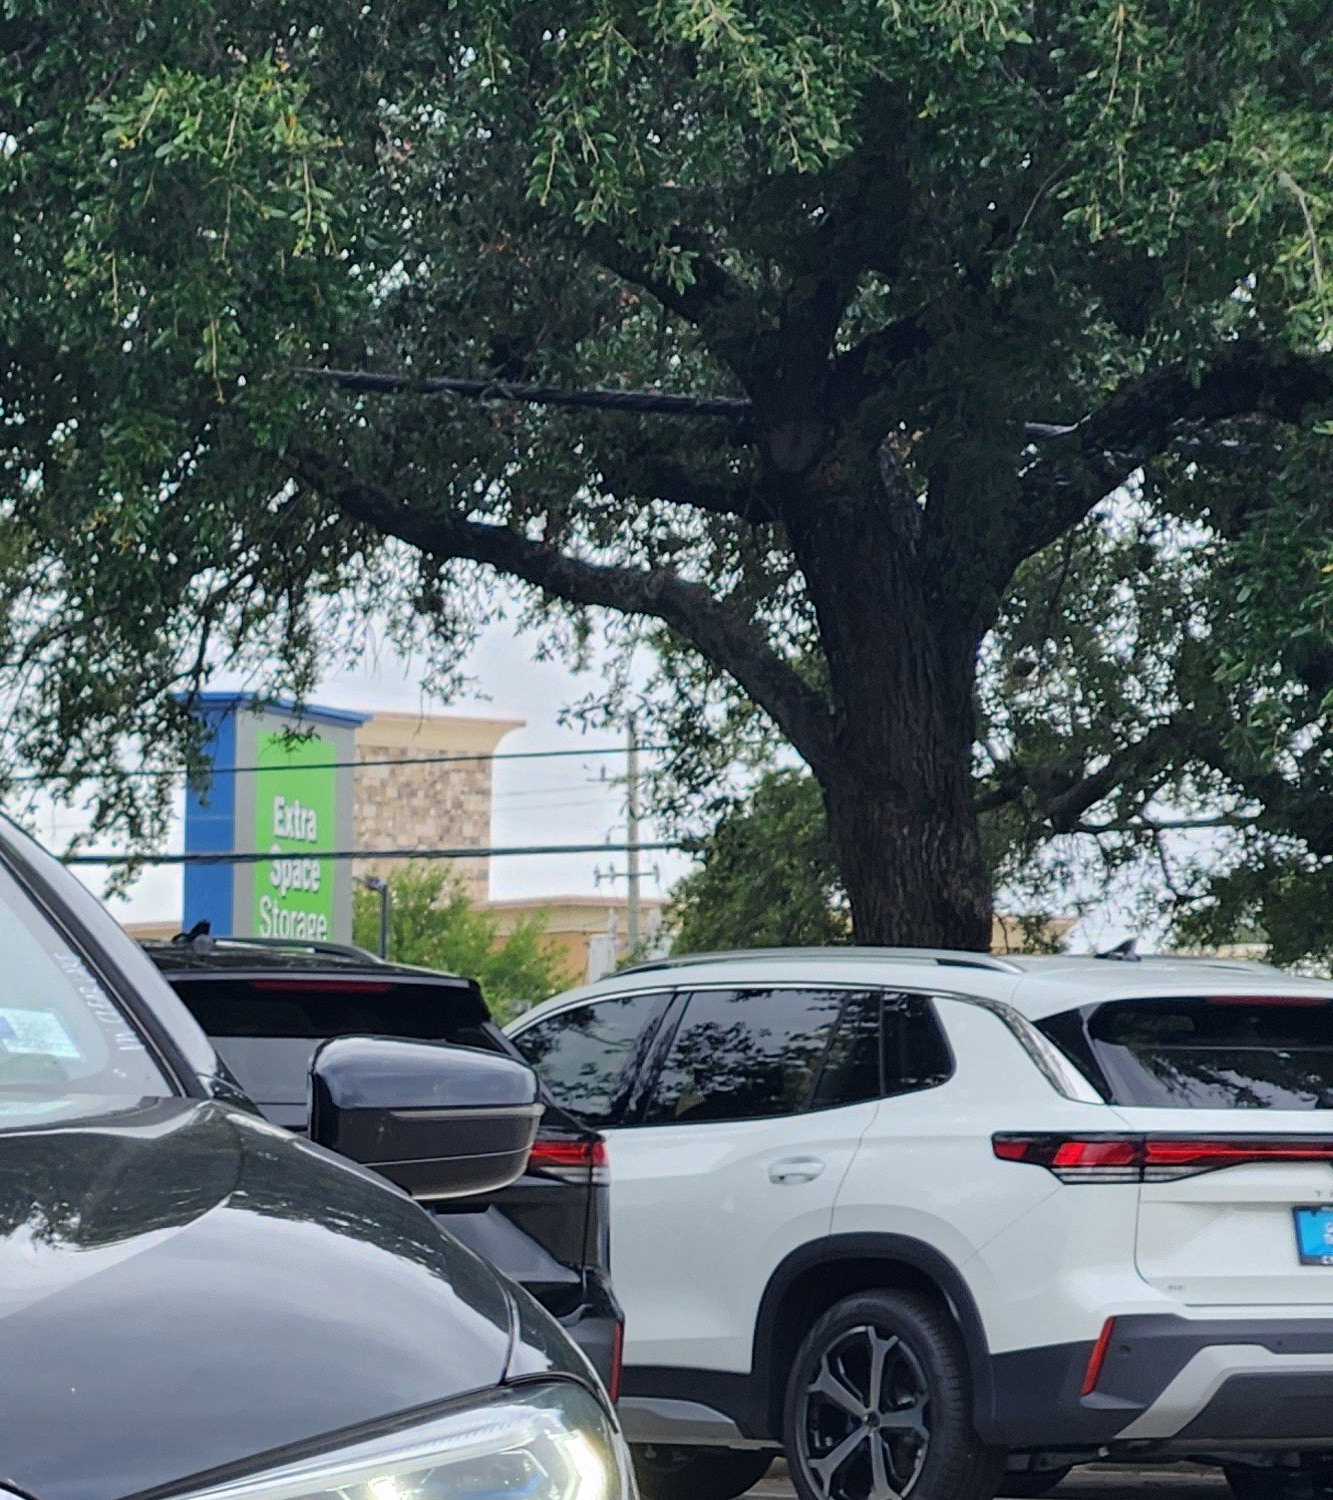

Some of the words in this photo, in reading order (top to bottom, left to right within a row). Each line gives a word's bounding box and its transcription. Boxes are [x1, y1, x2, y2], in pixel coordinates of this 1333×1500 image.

[273, 796, 317, 841] Extra
[269, 843, 321, 896] Space
[259, 895, 328, 940] Storage
